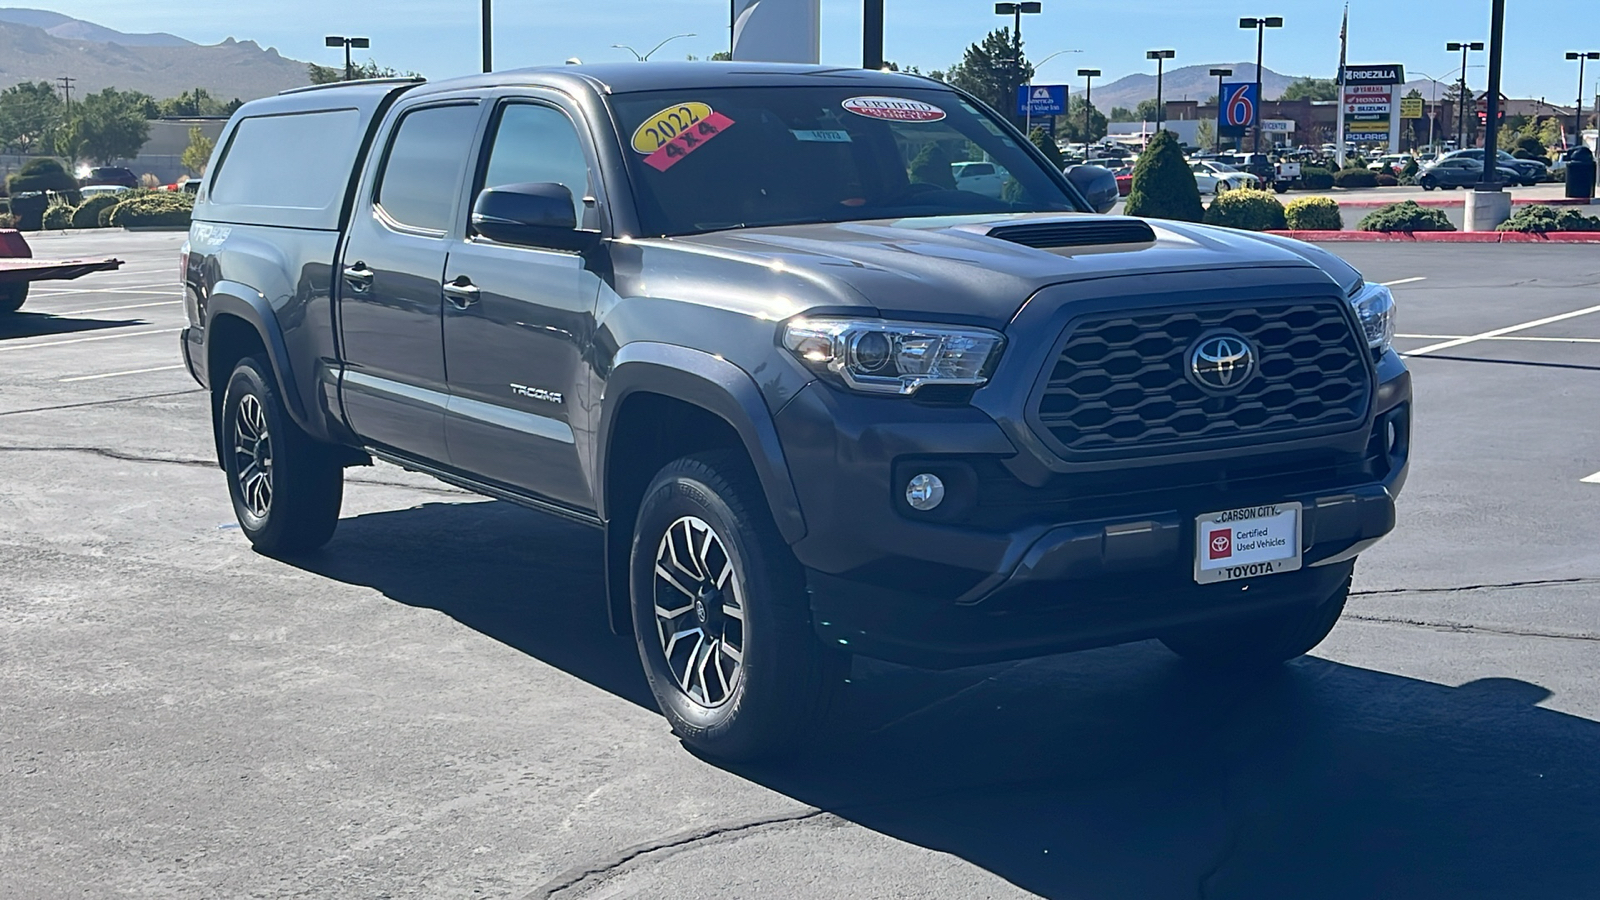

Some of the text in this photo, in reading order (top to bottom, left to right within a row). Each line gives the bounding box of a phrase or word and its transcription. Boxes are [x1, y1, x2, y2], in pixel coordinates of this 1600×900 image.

[1352, 70, 1396, 79] RIDEZILLA
[852, 100, 932, 112] CERTIFIED
[1227, 84, 1254, 126] 6
[645, 106, 700, 148] 2022
[510, 383, 562, 404] TACOMA
[1221, 505, 1276, 523] CARSON CITY
[1236, 527, 1268, 540] Certified
[1236, 538, 1286, 552] Used Vehicles
[1225, 562, 1274, 579] TOYOTA
